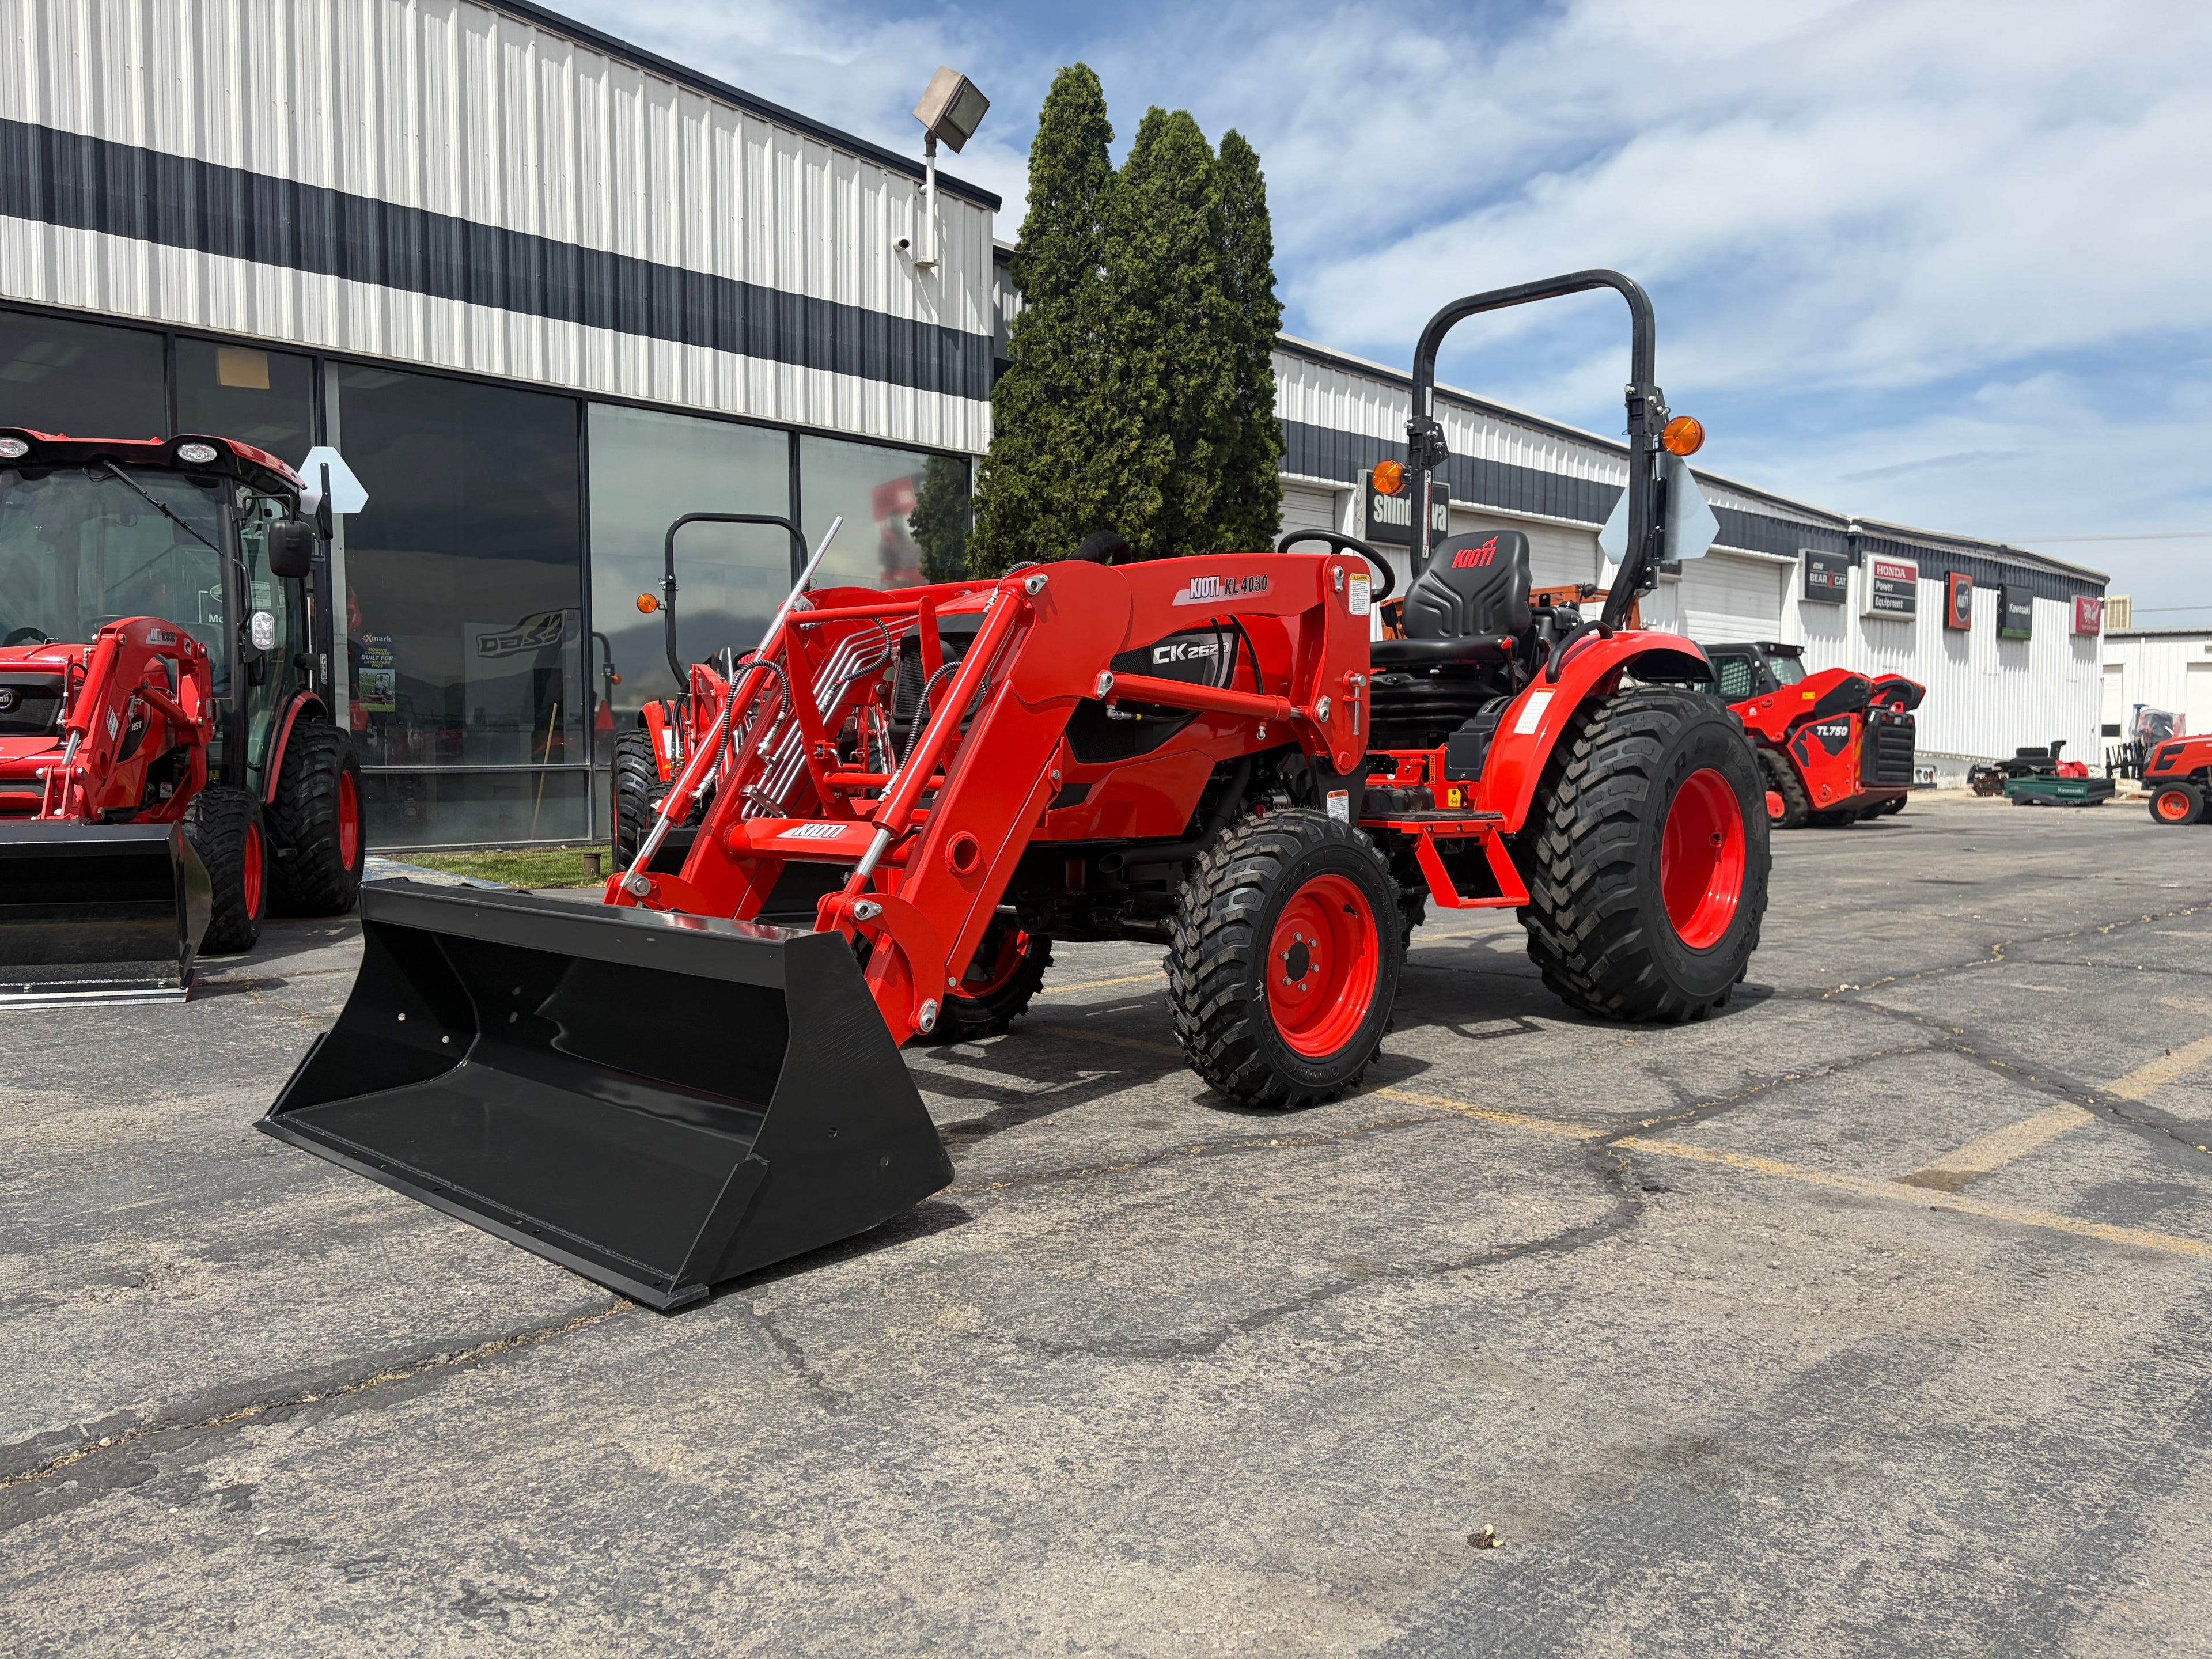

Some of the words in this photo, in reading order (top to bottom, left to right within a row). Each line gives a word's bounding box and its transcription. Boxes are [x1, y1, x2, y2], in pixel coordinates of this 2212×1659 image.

[1373, 493, 1446, 531] shindwa
[1451, 547, 1497, 569] KIOTI
[1876, 564, 1906, 578] HONDA
[1810, 573, 1827, 584] BEAR
[1835, 577, 1847, 586] CAT
[1876, 580, 1893, 592] Power
[1190, 575, 1221, 599] KIOTI
[1224, 578, 1239, 596] KL
[1241, 575, 1267, 594] 4030
[1875, 596, 1903, 609] Equipment
[2009, 601, 2031, 615] Kawasaki
[131, 721, 142, 731] HST
[1817, 726, 1848, 736] TL750
[791, 823, 849, 838] KIOTI
